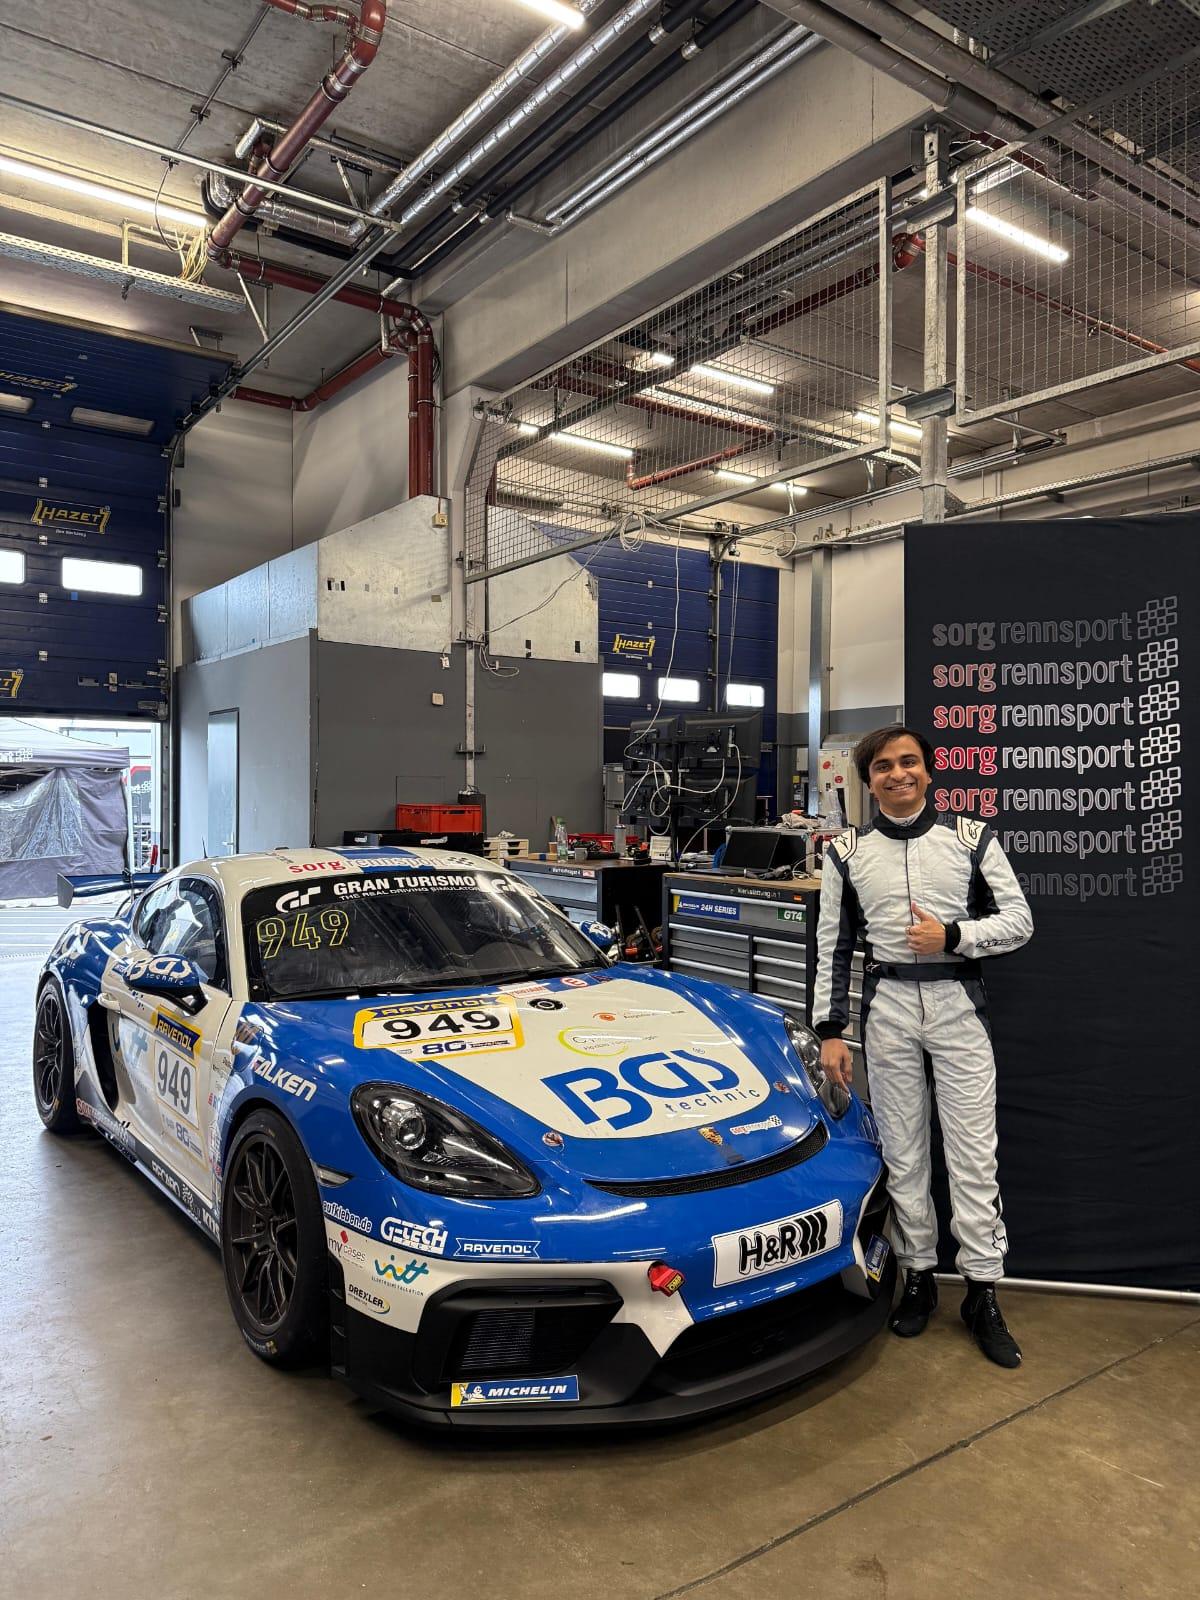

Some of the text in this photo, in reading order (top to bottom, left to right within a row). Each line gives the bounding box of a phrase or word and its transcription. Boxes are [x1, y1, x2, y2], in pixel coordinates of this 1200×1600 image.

[41, 506, 102, 523] HAZET
[619, 639, 650, 649] HAZET
[932, 612, 1132, 650] sorg rennsport
[933, 655, 1133, 692] sorg rennsport
[933, 697, 1134, 734] sorg rennsport
[934, 739, 1135, 775] sorg rennsport
[934, 782, 1136, 817] sorg rennsport
[1004, 825, 1136, 859] rennsport
[288, 860, 346, 874] sorg
[333, 875, 476, 896] GRAN TURISMO
[339, 891, 360, 901] THE
[361, 889, 389, 897] REAL
[390, 886, 429, 894] DRIVING
[1018, 868, 1137, 902] ennsport
[700, 903, 713, 912] 24H
[714, 905, 737, 915] SERIES
[783, 910, 803, 921] GT4
[256, 908, 350, 959] 949
[382, 998, 491, 1017] RAVENOL
[157, 1020, 194, 1051] RAVENOL
[383, 1010, 501, 1039] 949
[157, 1050, 192, 1115] 949
[251, 1052, 317, 1102] FALKEN
[664, 1088, 761, 1113] technic
[322, 1200, 373, 1233] aufkleben.de
[463, 1243, 532, 1255] RAVENOL
[739, 1223, 800, 1274] H&R
[487, 1384, 568, 1397] MICHELIN
